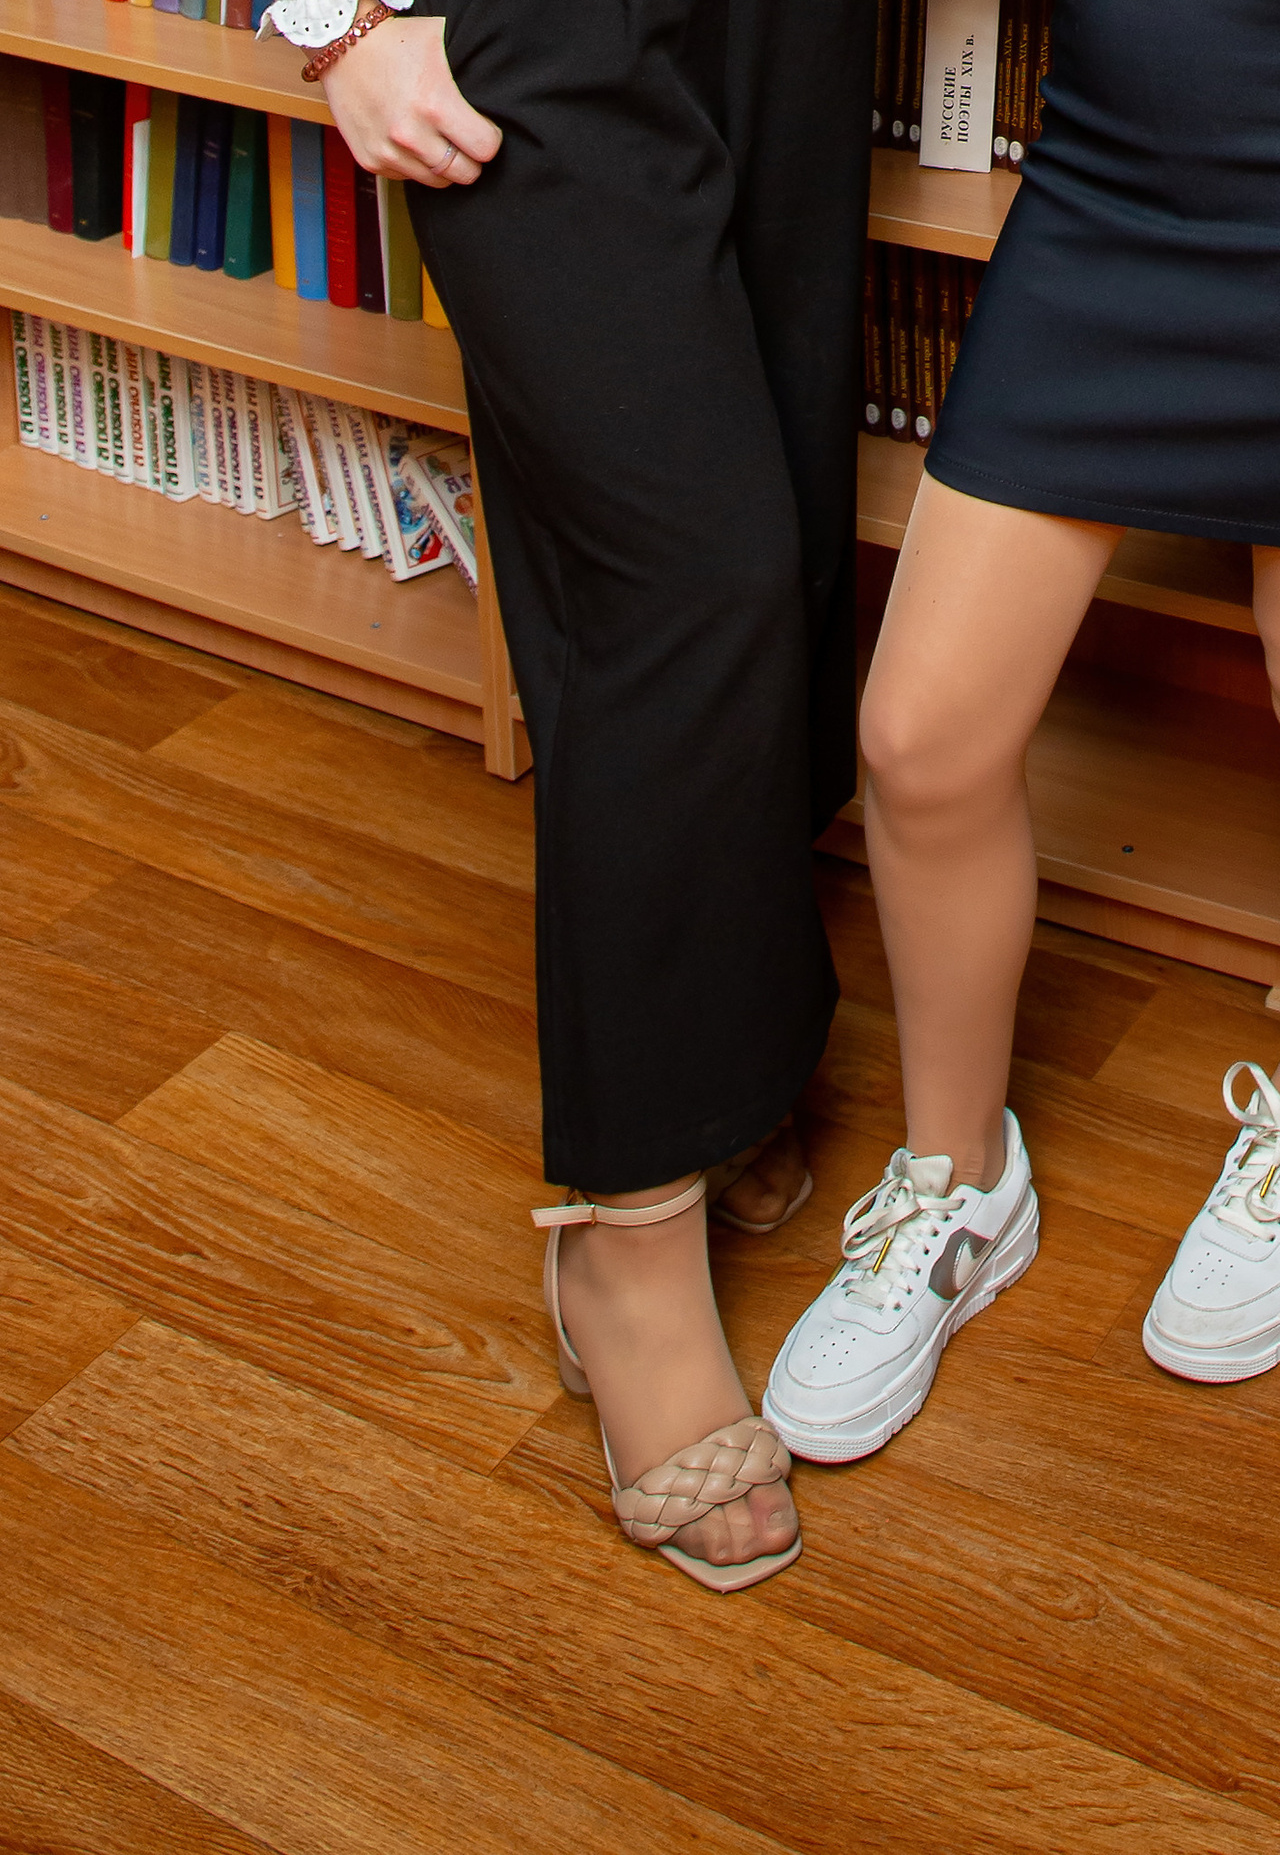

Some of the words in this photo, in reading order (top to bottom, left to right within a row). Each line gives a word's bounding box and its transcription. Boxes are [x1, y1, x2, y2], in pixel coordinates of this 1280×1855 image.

[962, 51, 973, 76] XIX
[966, 34, 974, 45] в.
[941, 67, 956, 140] РУССКИЕ
[957, 86, 971, 143] ПОЭТЫ
[16, 346, 32, 416] ПОЗНАЮ
[34, 353, 48, 422] ПОЗНАЮ
[54, 363, 67, 427] ПОЗНАЮ
[70, 365, 84, 436] ПОЗНАЮ
[93, 371, 108, 443] ПОЗНАЮ
[108, 378, 123, 450] ПОЗНАЮ
[129, 387, 143, 450] ПОЗНАЮ
[161, 395, 177, 468] ПОЗНАЮ
[212, 407, 226, 475] ПОЗНАЮ
[226, 407, 240, 481] ПОЗНАЮ
[248, 410, 263, 482] ПОЗНАЮ
